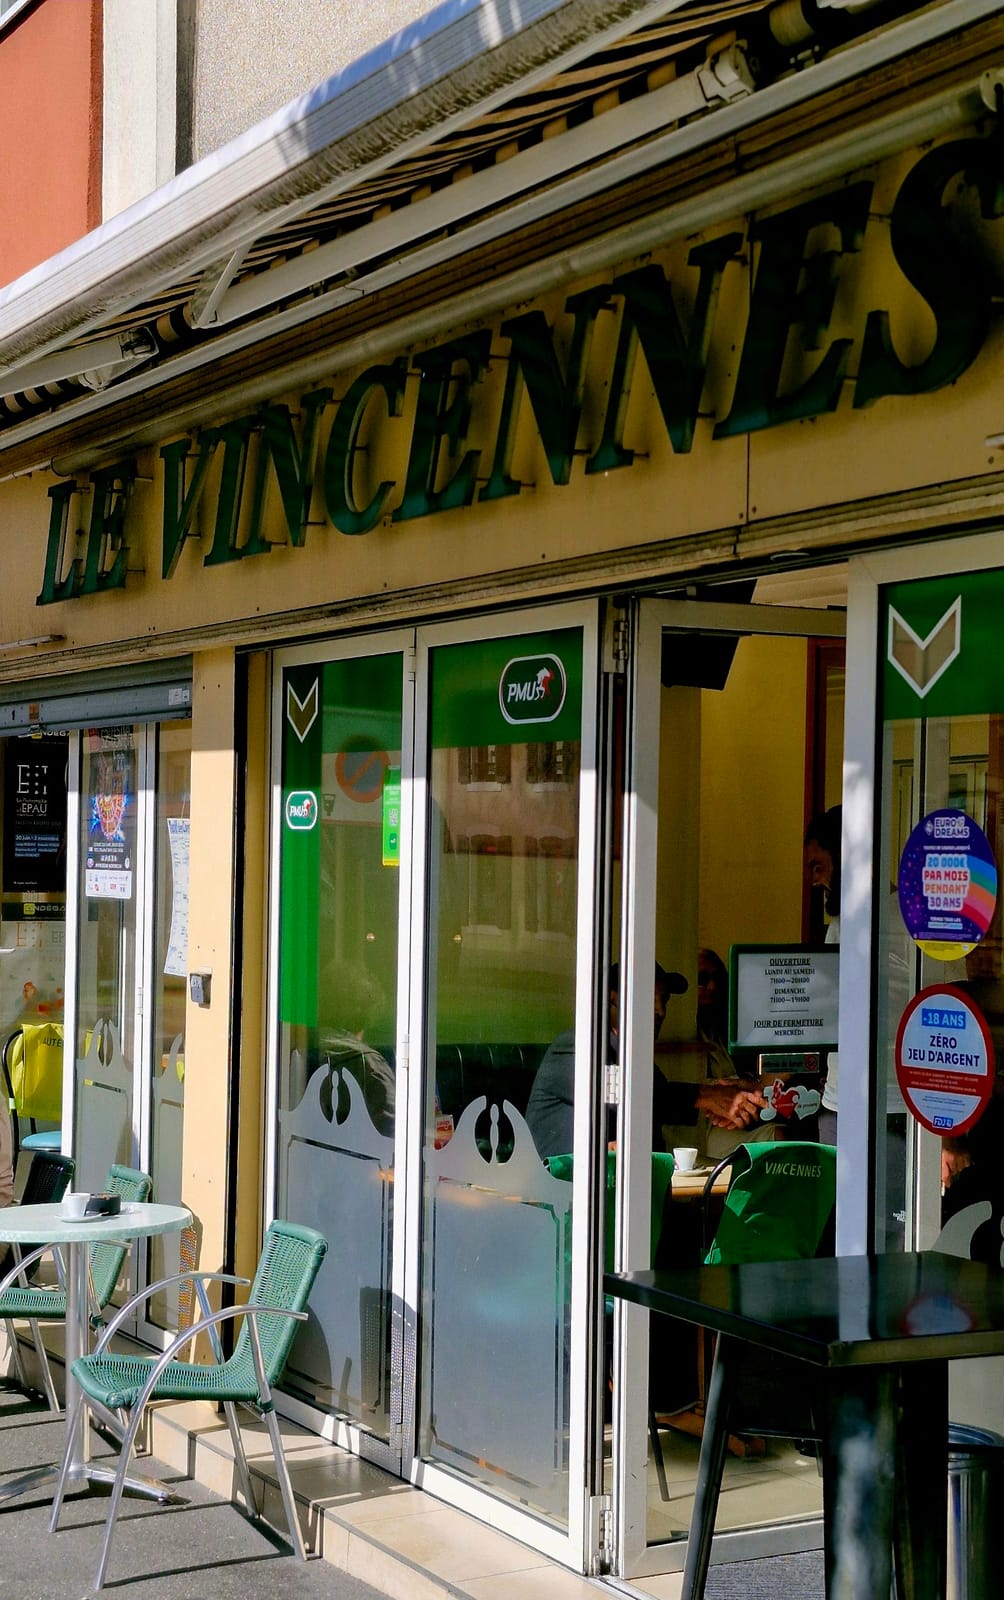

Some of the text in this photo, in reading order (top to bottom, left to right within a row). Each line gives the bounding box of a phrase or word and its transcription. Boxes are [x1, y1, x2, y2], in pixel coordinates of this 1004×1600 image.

[36, 138, 1004, 606] LE VINCENNES
[507, 681, 537, 703] PMU
[290, 806, 306, 816] PMU
[935, 818, 957, 828] EURO
[935, 827, 969, 837] DREAMS
[928, 857, 939, 867] 20
[924, 871, 968, 881] PAR MOIS
[925, 884, 967, 895] PENDANT
[930, 897, 961, 909] 30 ANS
[770, 958, 811, 966] OUVERTURE
[754, 1020, 771, 1028] JOUR
[783, 1019, 823, 1027] FERMETURE
[923, 1012, 964, 1027] -18 ANS
[930, 1032, 957, 1049] ZÉRO
[908, 1048, 980, 1067] JEU D'ARGENT
[765, 1161, 822, 1177] VINCENNES
